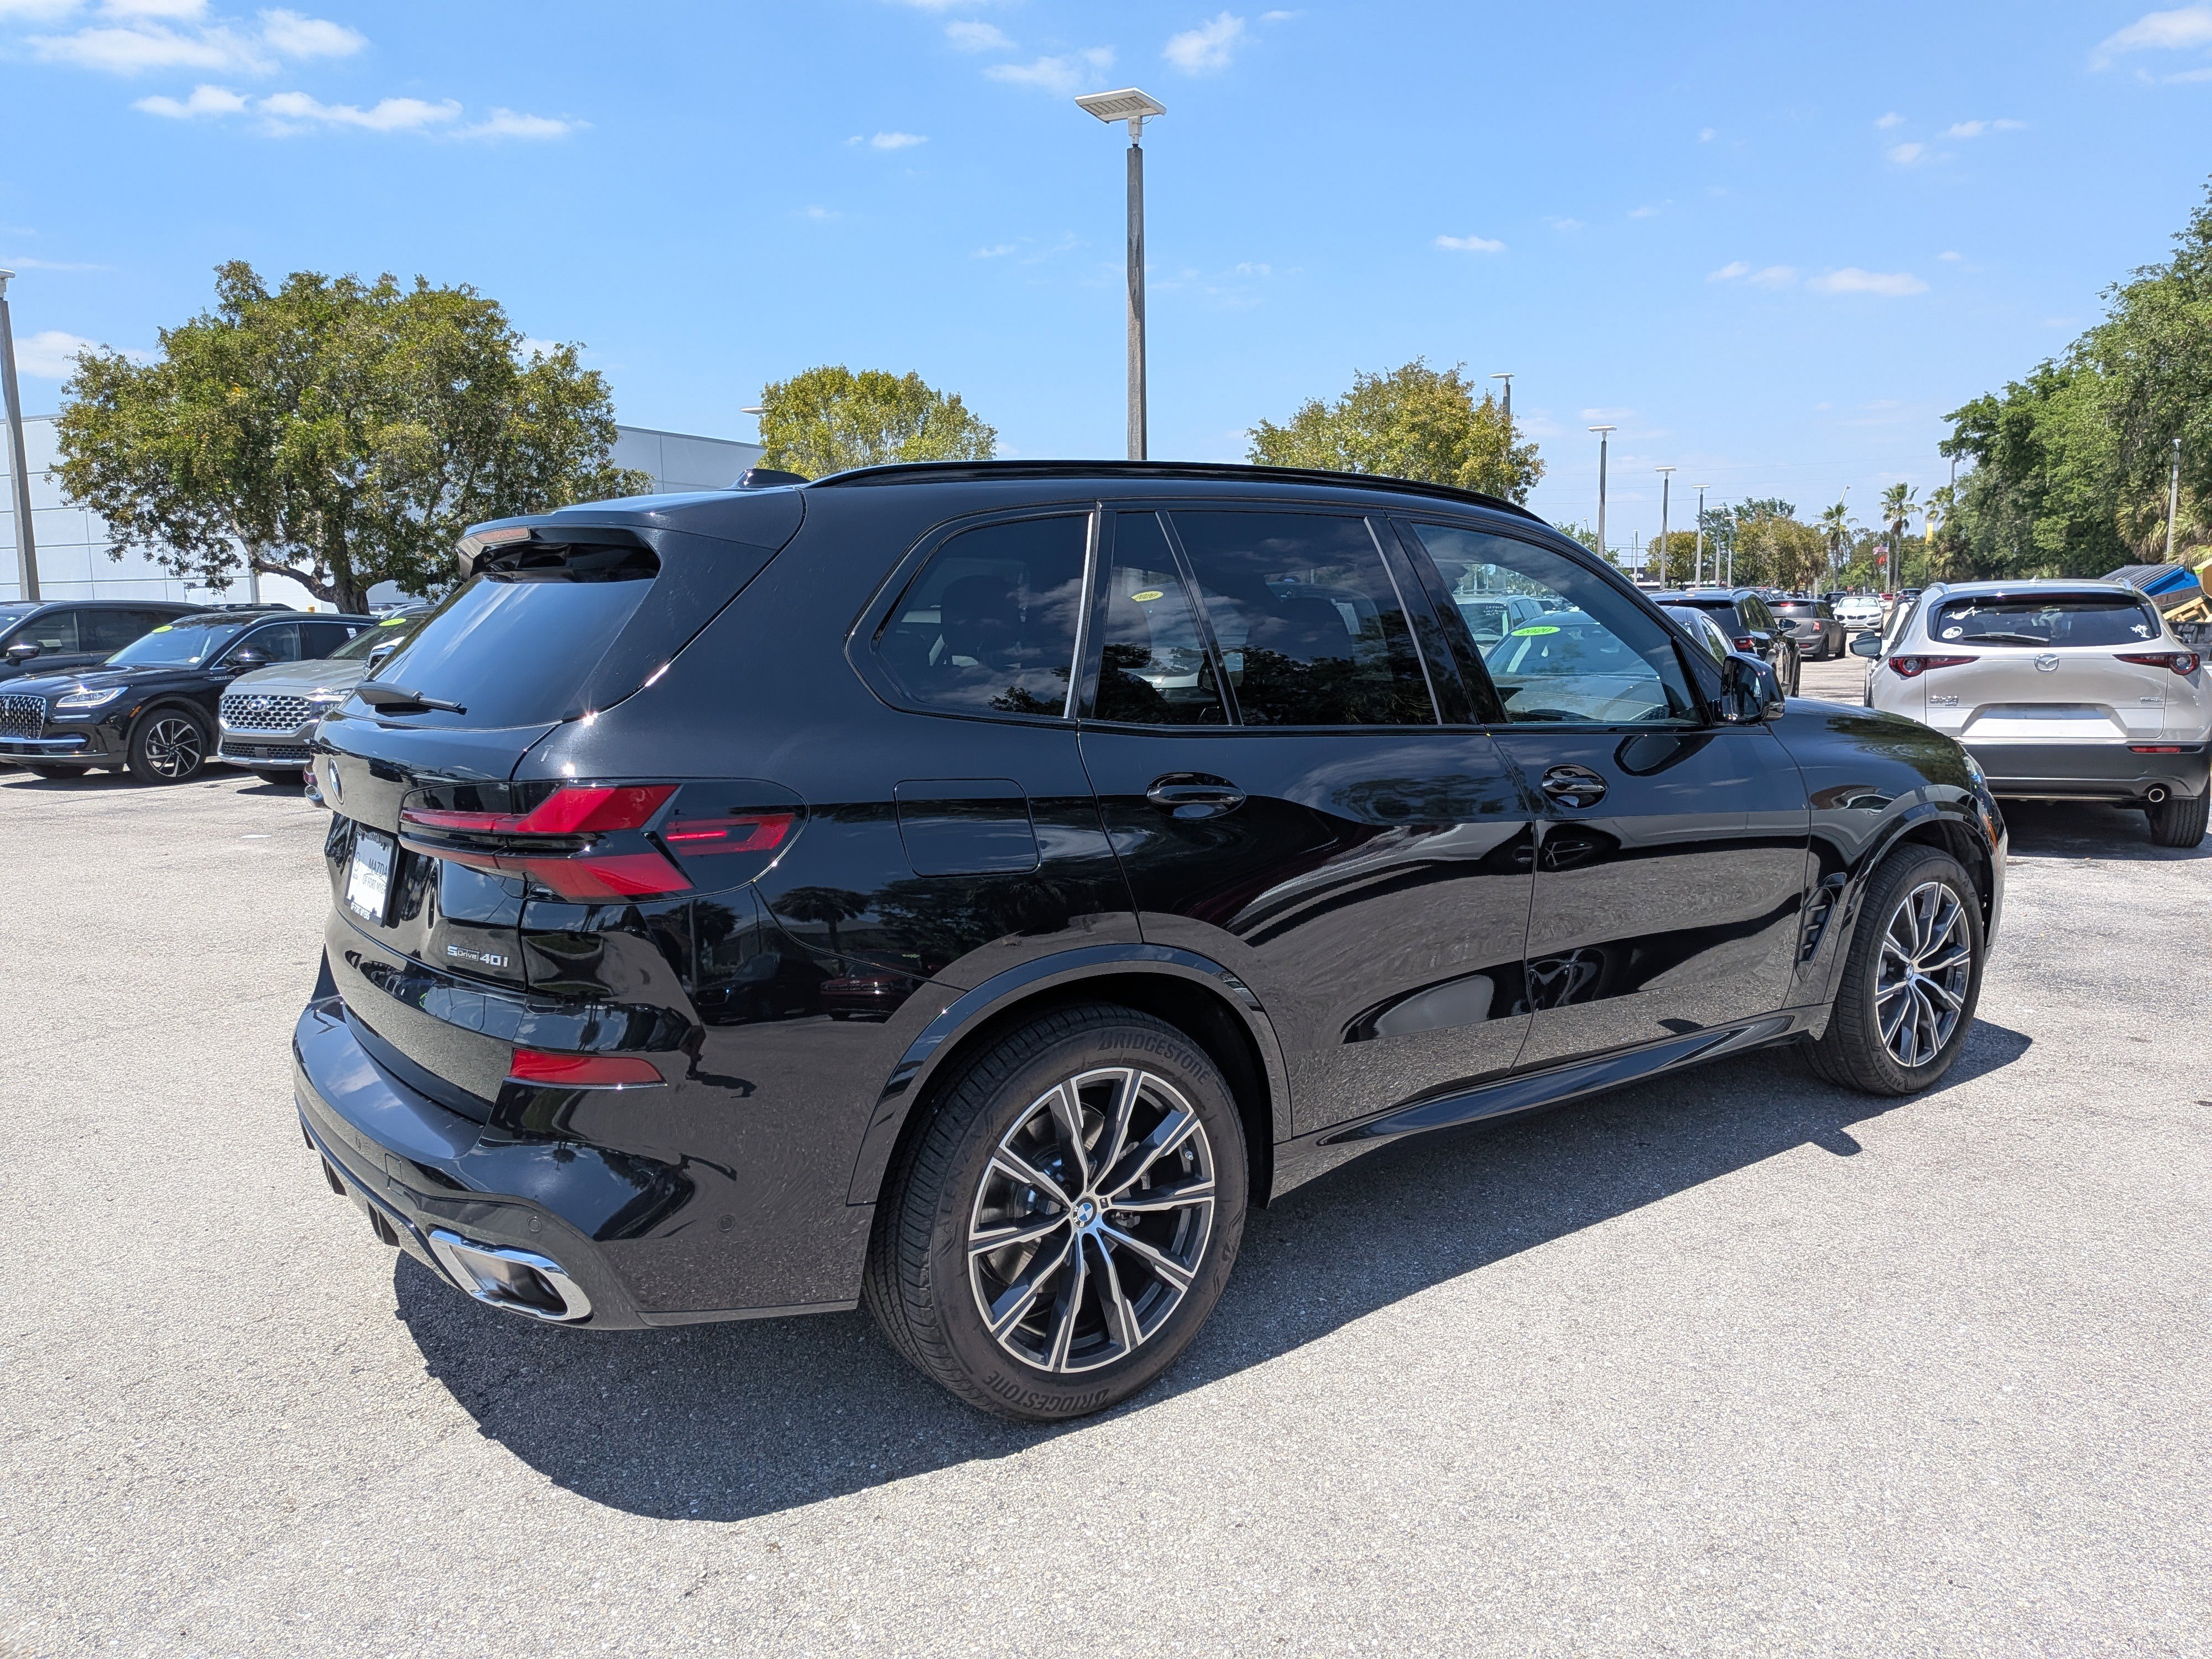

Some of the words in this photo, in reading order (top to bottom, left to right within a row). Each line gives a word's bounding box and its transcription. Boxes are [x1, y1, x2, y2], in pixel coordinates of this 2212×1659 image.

[368, 858, 388, 880] MAZDA
[1097, 1031, 1211, 1086] BRIDGESTONE
[982, 1369, 1110, 1412] BRIDGESTONE
